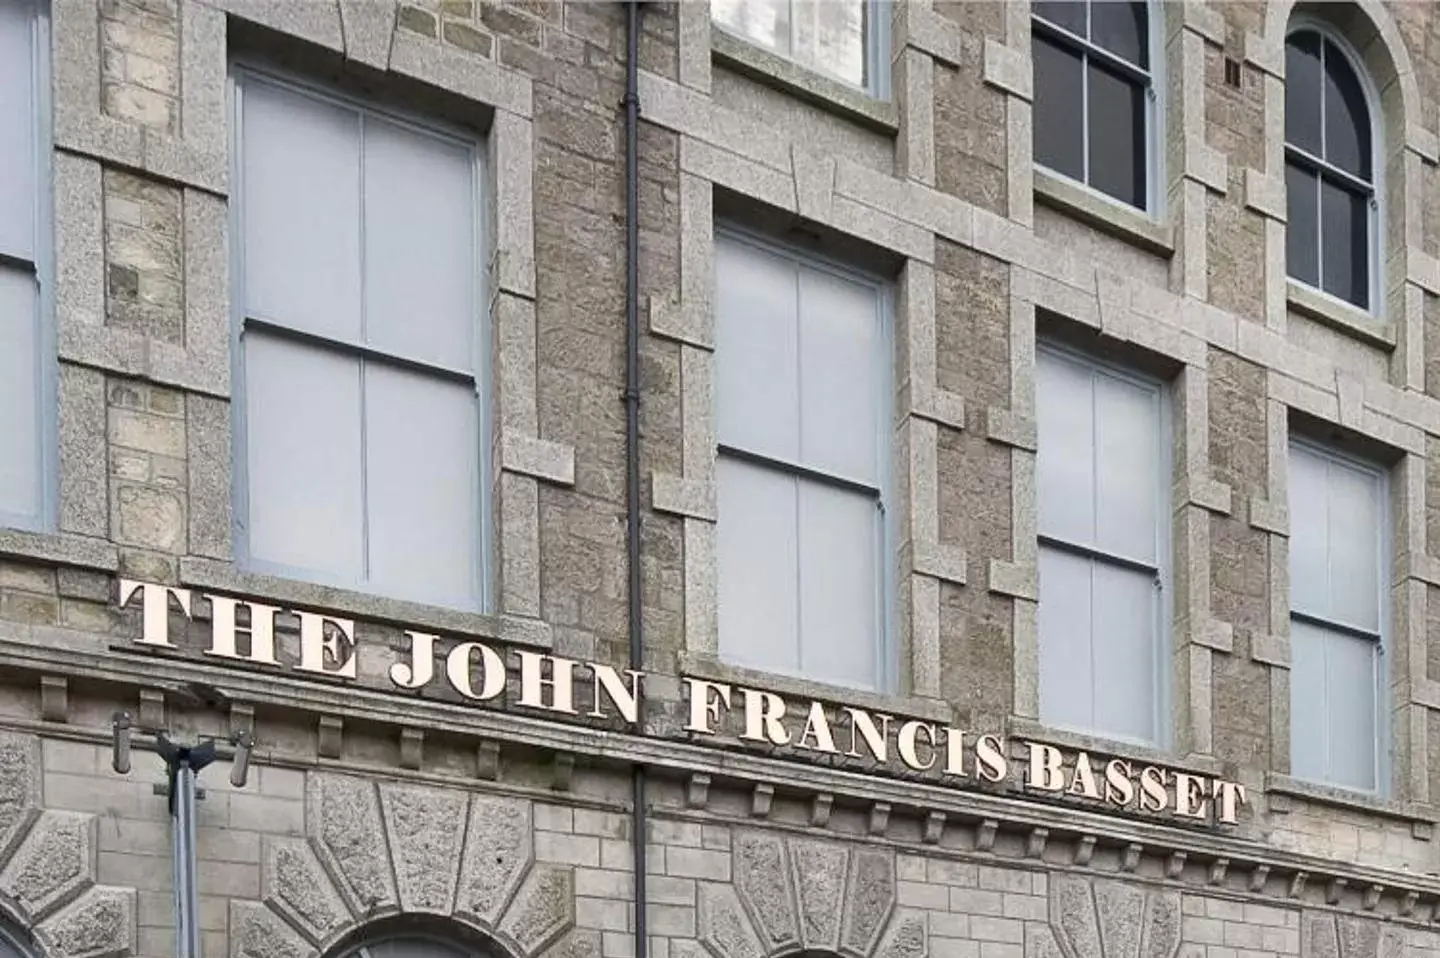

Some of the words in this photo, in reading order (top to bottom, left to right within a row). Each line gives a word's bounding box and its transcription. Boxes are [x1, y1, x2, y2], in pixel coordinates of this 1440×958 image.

[120, 578, 358, 680] THE
[388, 629, 646, 724] JOHN
[682, 676, 1008, 782] FRANCIS
[1025, 741, 1248, 826] BASSET
